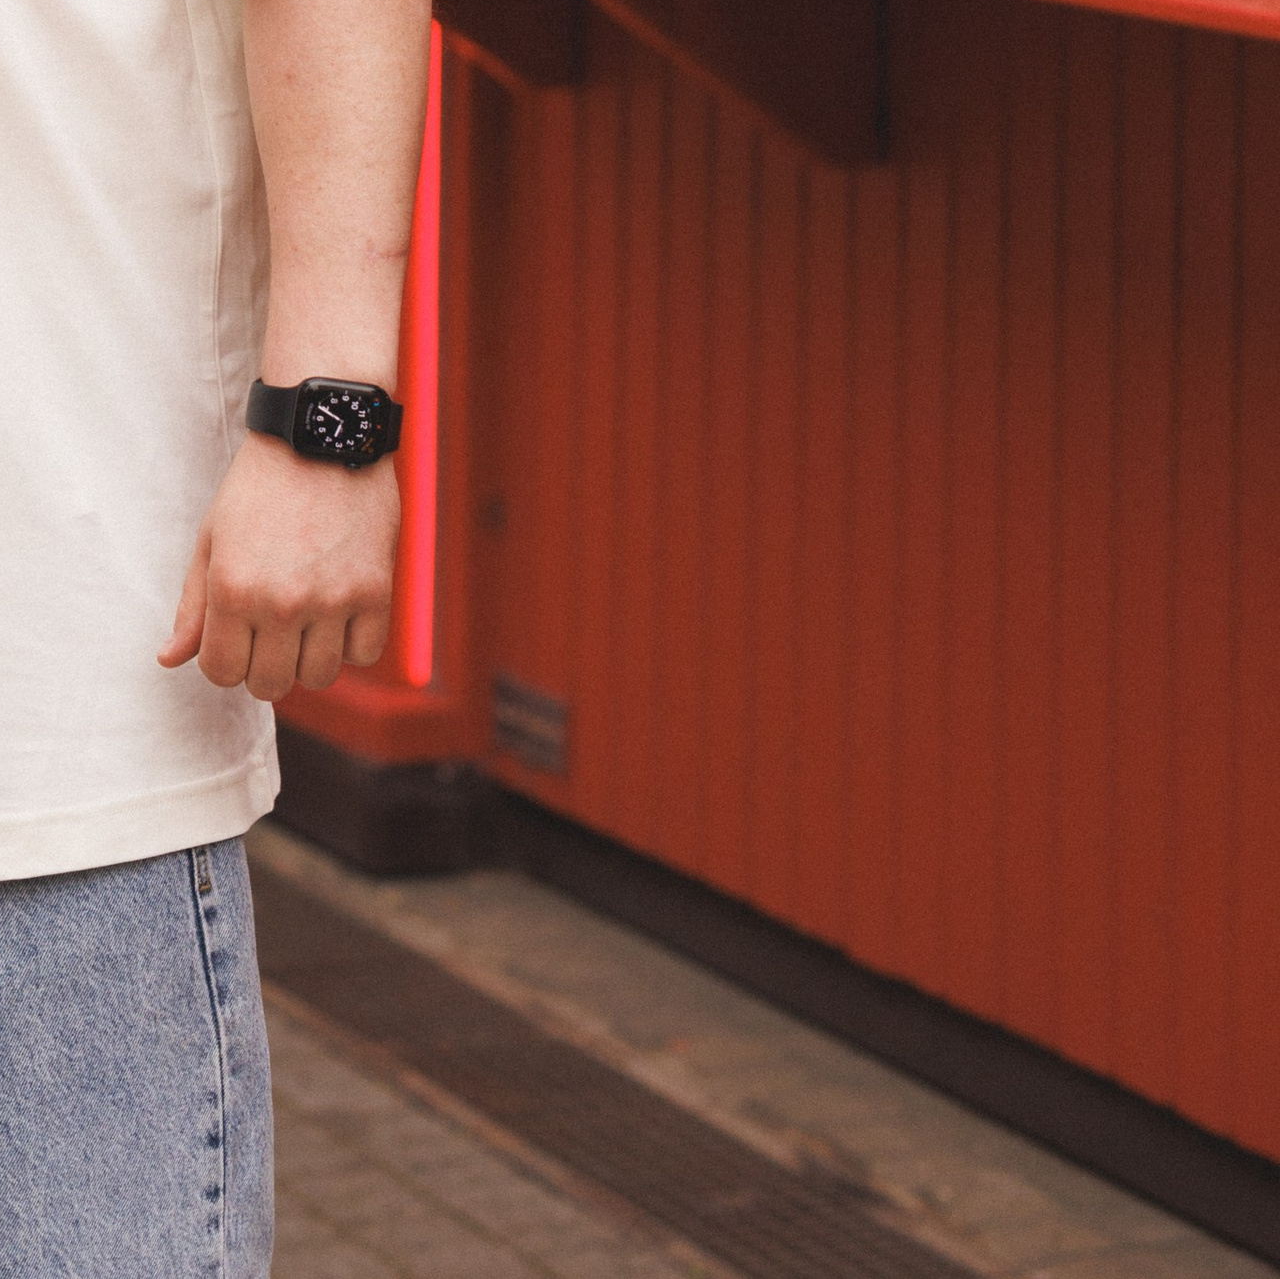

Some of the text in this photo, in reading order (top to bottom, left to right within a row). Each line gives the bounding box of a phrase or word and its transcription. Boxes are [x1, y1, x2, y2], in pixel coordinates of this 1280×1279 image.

[351, 401, 359, 410] 10
[358, 410, 366, 418] 11
[360, 420, 368, 429] 12
